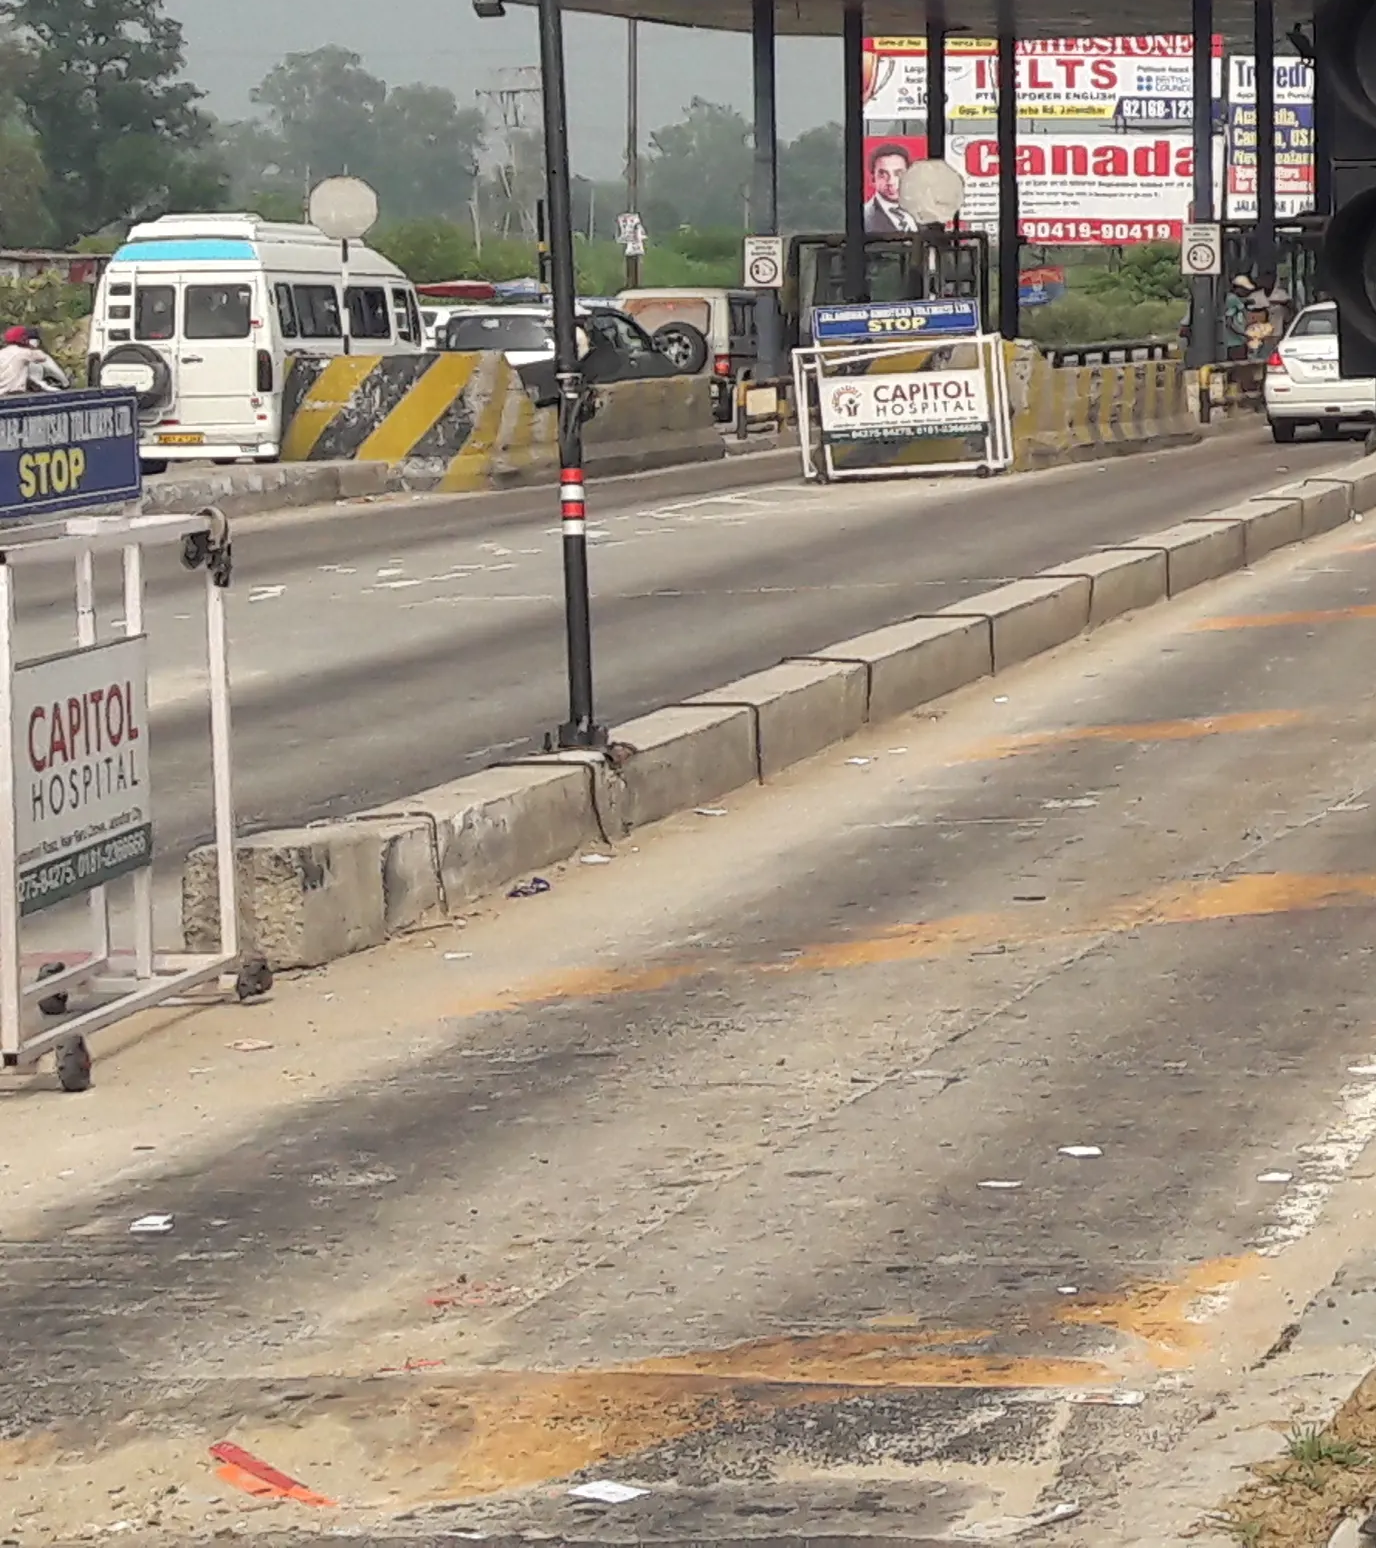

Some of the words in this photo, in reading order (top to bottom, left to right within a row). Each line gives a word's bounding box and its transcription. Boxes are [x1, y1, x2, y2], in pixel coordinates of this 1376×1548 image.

[1234, 60, 1307, 89] Tredi
[867, 316, 927, 333] STOP
[873, 380, 976, 403] CAPITOL
[876, 399, 976, 418] HOSPITAL
[19, 446, 85, 498] STOP
[28, 680, 139, 773] CAPITOL
[31, 749, 141, 822] HOSPITAL
